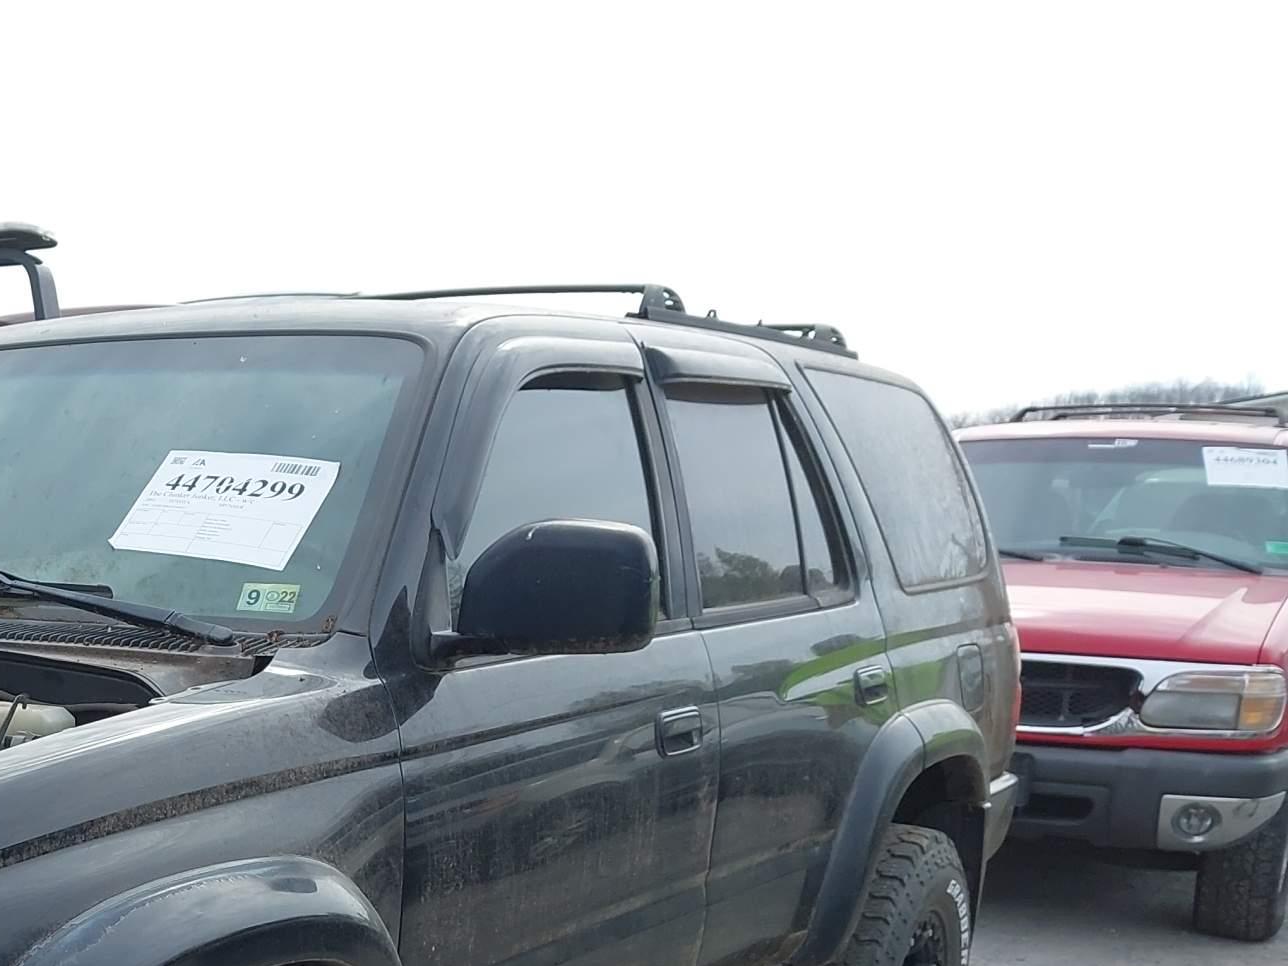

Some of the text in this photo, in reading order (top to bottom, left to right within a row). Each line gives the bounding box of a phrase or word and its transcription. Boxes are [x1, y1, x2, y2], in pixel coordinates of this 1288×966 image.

[165, 473, 305, 501] 44704299
[246, 589, 261, 605] 9
[278, 590, 297, 603] 22
